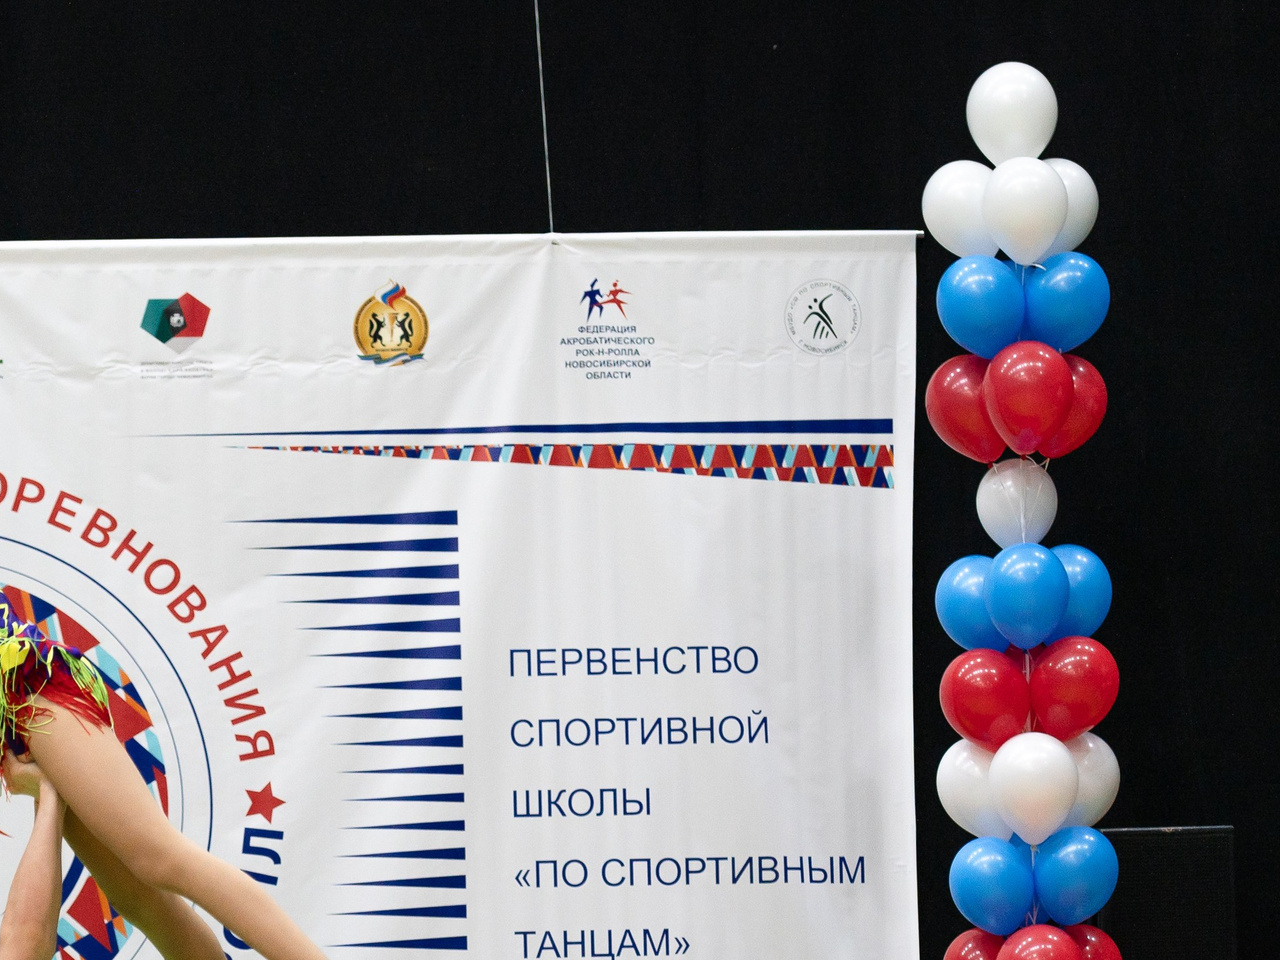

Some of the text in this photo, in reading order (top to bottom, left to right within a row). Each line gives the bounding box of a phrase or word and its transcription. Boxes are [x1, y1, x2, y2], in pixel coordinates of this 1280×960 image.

[577, 325, 637, 335] ФЕДЕРАЦИЯ
[559, 336, 656, 346] АКРОБАТИЧЕСКОГО
[575, 348, 641, 357] РОК-Н-РОЛЛА
[564, 358, 652, 369] НОВОСИБИРСКОЙ
[585, 371, 632, 380] ОБЛАСТИ
[509, 645, 759, 677] ПЕРВЕНСТВО
[510, 709, 770, 748] СПОРТИВНОЙ
[512, 787, 651, 818] ШКОЛЫ
[514, 855, 866, 888] «ПО СПОРТИВНЫМ
